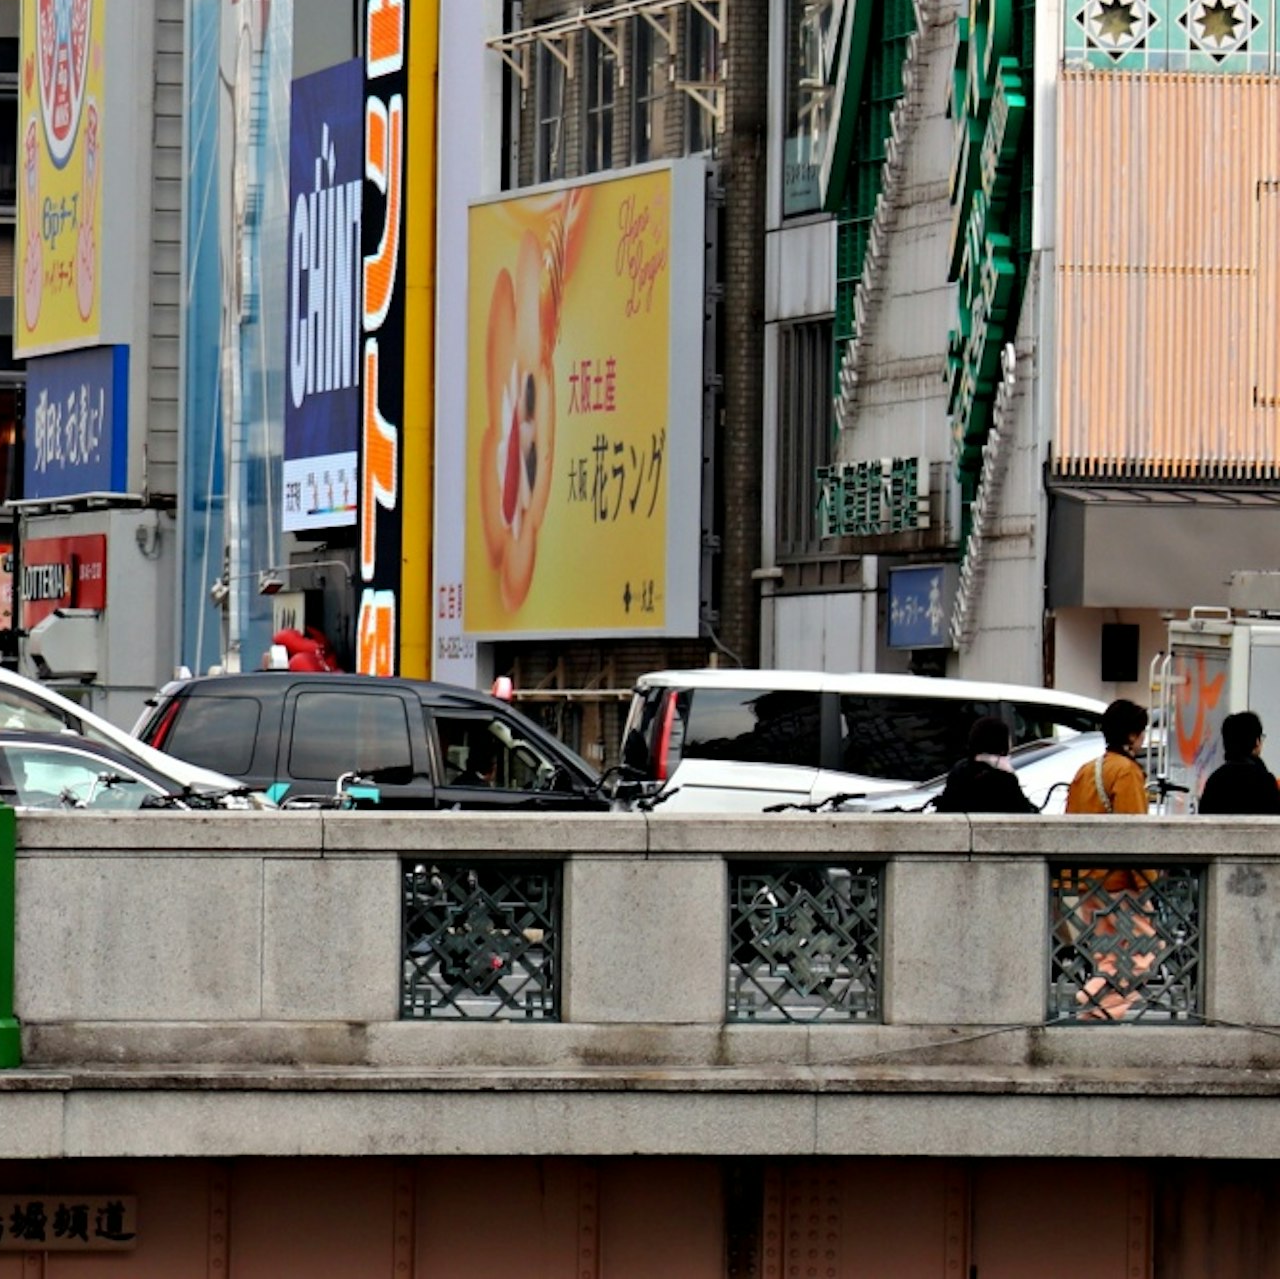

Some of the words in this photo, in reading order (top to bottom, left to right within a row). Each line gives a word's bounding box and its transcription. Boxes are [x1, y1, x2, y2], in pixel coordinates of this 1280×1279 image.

[568, 354, 617, 416] 大阪土産
[590, 427, 666, 524] 花ラング
[21, 563, 64, 601] LOTTERIA
